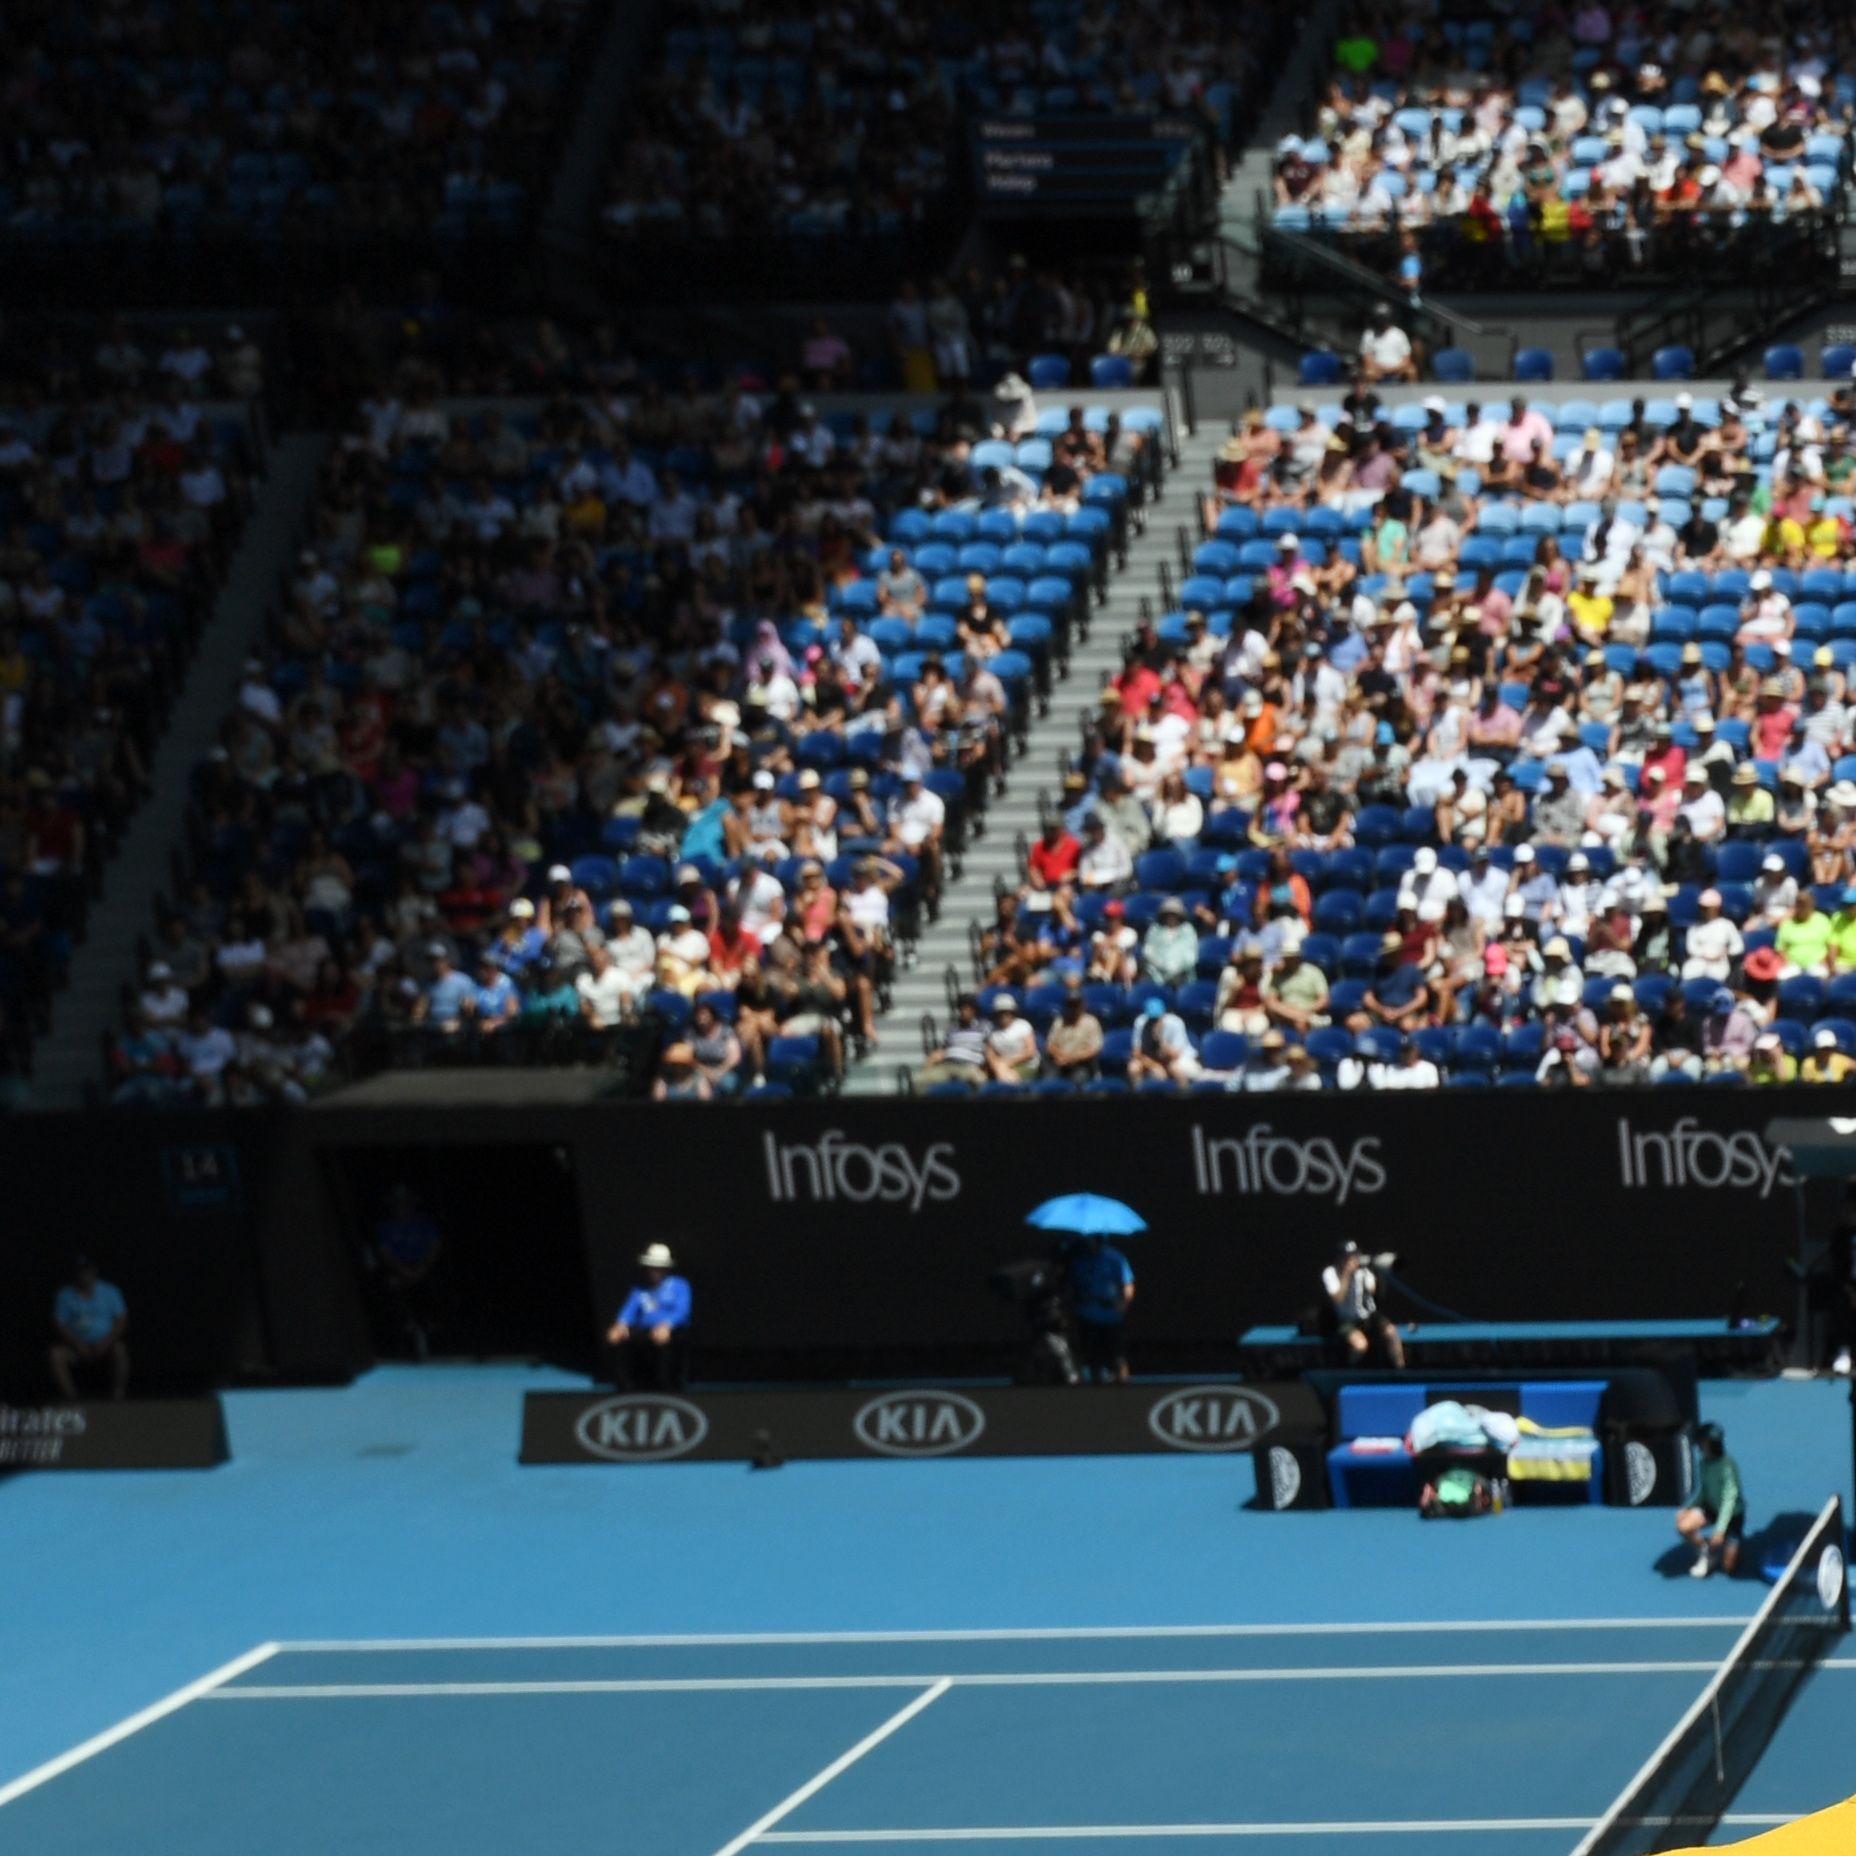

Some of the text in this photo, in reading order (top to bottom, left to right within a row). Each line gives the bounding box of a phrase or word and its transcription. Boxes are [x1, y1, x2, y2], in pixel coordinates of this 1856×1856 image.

[762, 1129, 962, 1213] Infosys
[1192, 1121, 1388, 1206] Infosys
[600, 1408, 687, 1447] KIA
[876, 1404, 964, 1442] KIA
[1171, 1400, 1257, 1437] KIA
